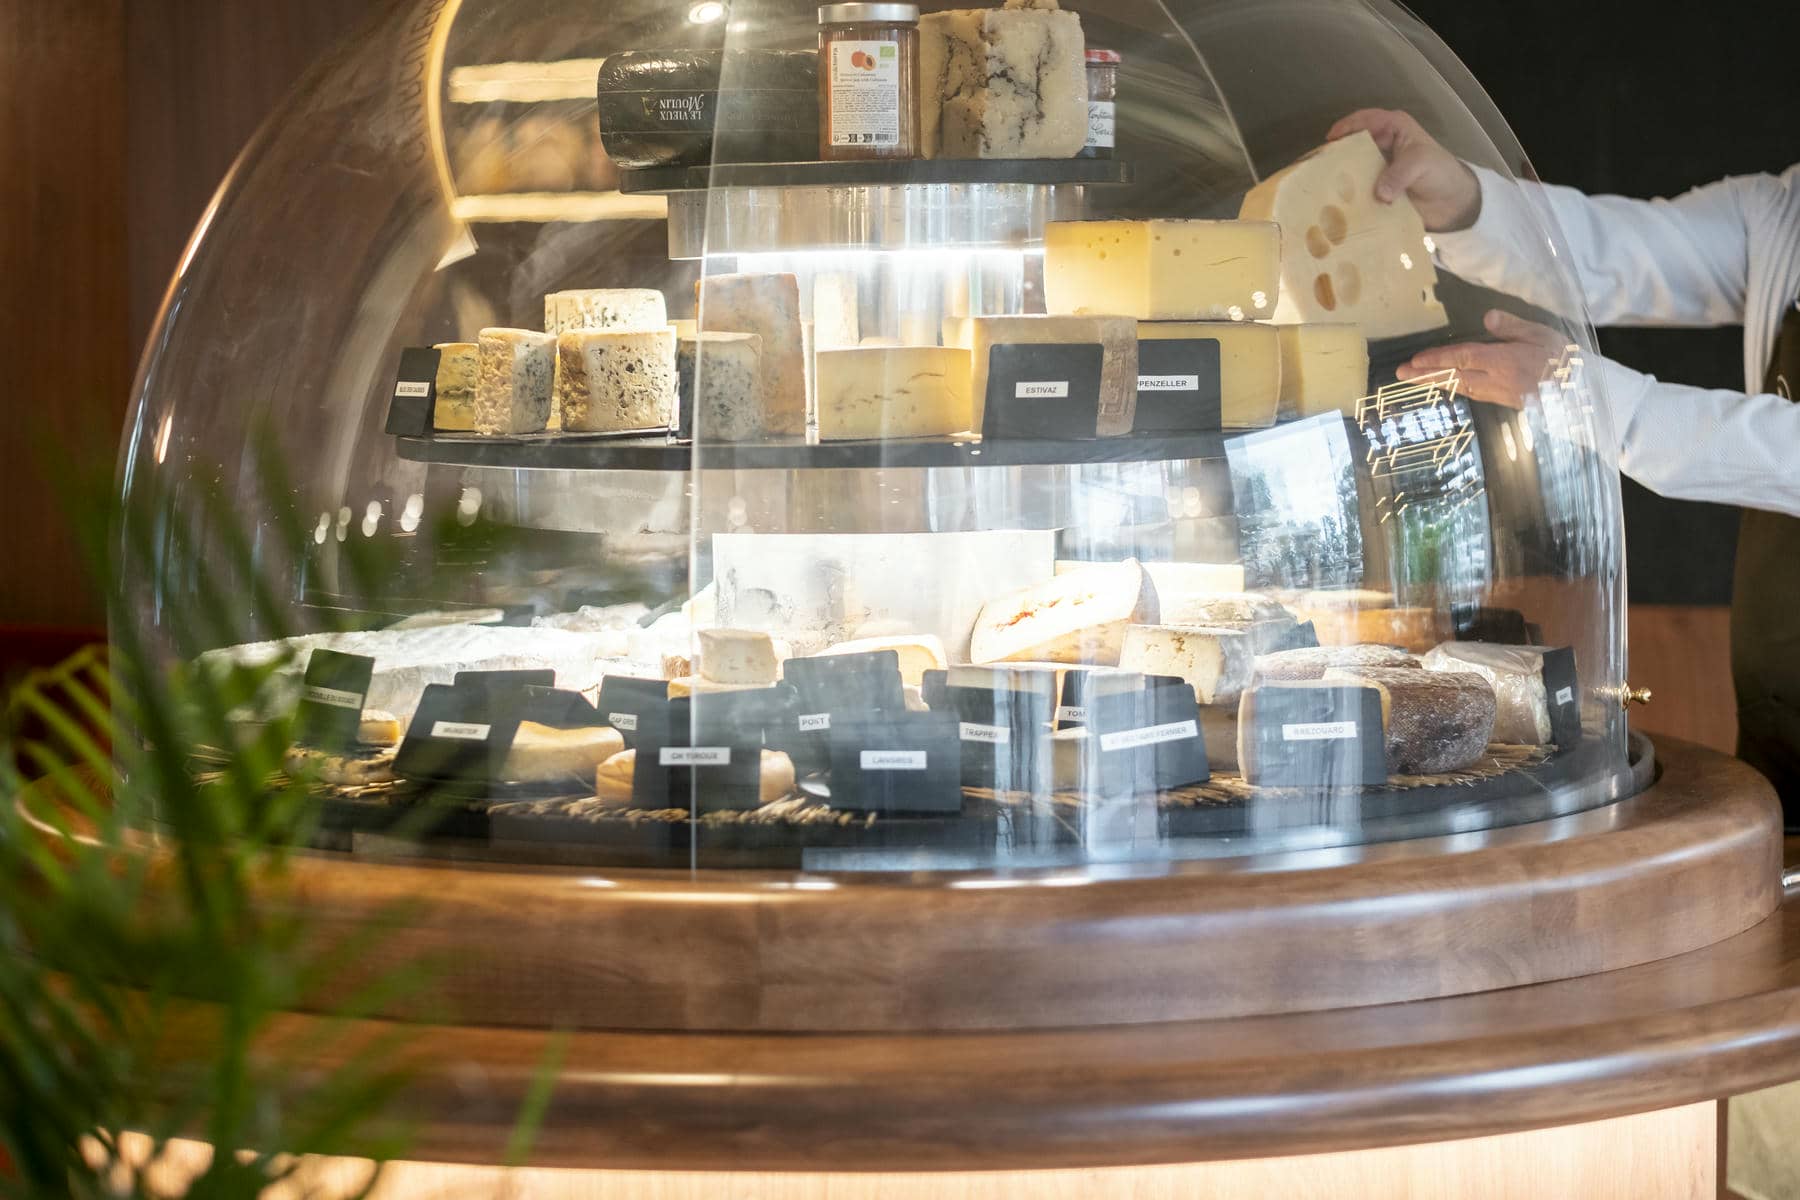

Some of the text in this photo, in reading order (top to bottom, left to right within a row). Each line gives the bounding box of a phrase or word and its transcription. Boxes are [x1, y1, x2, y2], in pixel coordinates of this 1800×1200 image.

[660, 110, 702, 121] LE VIEUX
[1137, 380, 1187, 388] PENZELLER
[1025, 386, 1057, 394] ESTIVAZ
